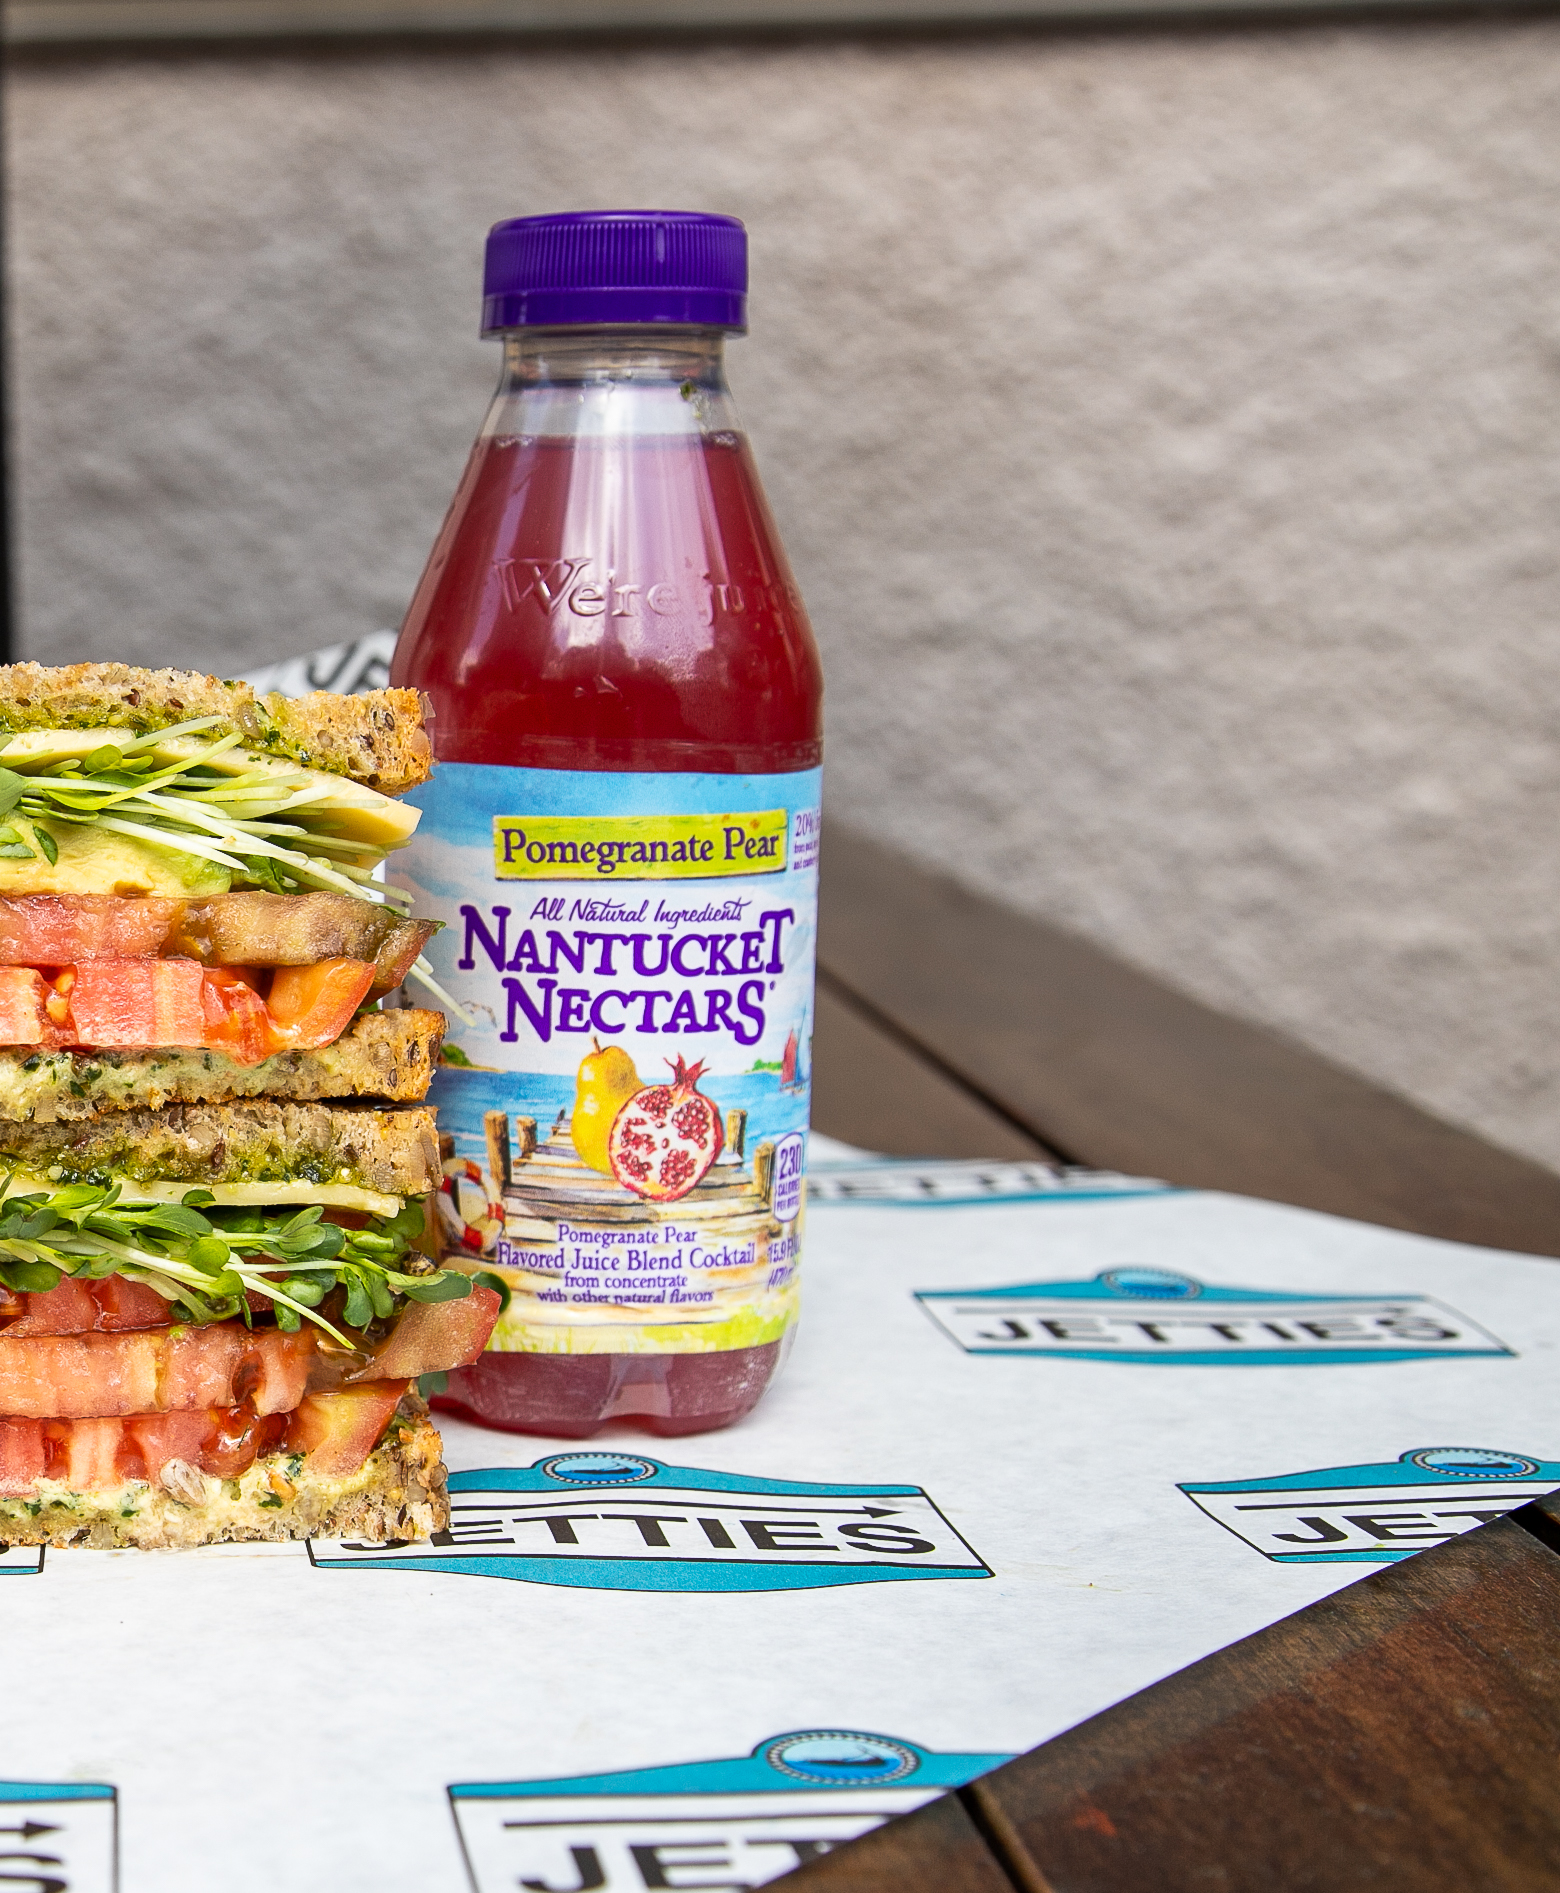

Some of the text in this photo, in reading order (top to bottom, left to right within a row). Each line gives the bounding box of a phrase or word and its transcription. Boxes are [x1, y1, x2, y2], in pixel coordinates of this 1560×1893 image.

[501, 826, 779, 874] Pomegranate Pear
[530, 896, 752, 930] All Natural Ingredients
[458, 905, 795, 977] NANTUCKET
[500, 978, 766, 1046] NECTARS
[778, 1143, 802, 1179] 230
[558, 1224, 698, 1247] Pomegranate Pear
[497, 1242, 755, 1271] Flavored Juice Blend Cocktail
[564, 1271, 689, 1289] from concentrate
[537, 1288, 714, 1305] with other natural flavors
[977, 1314, 1461, 1343] JETTIES
